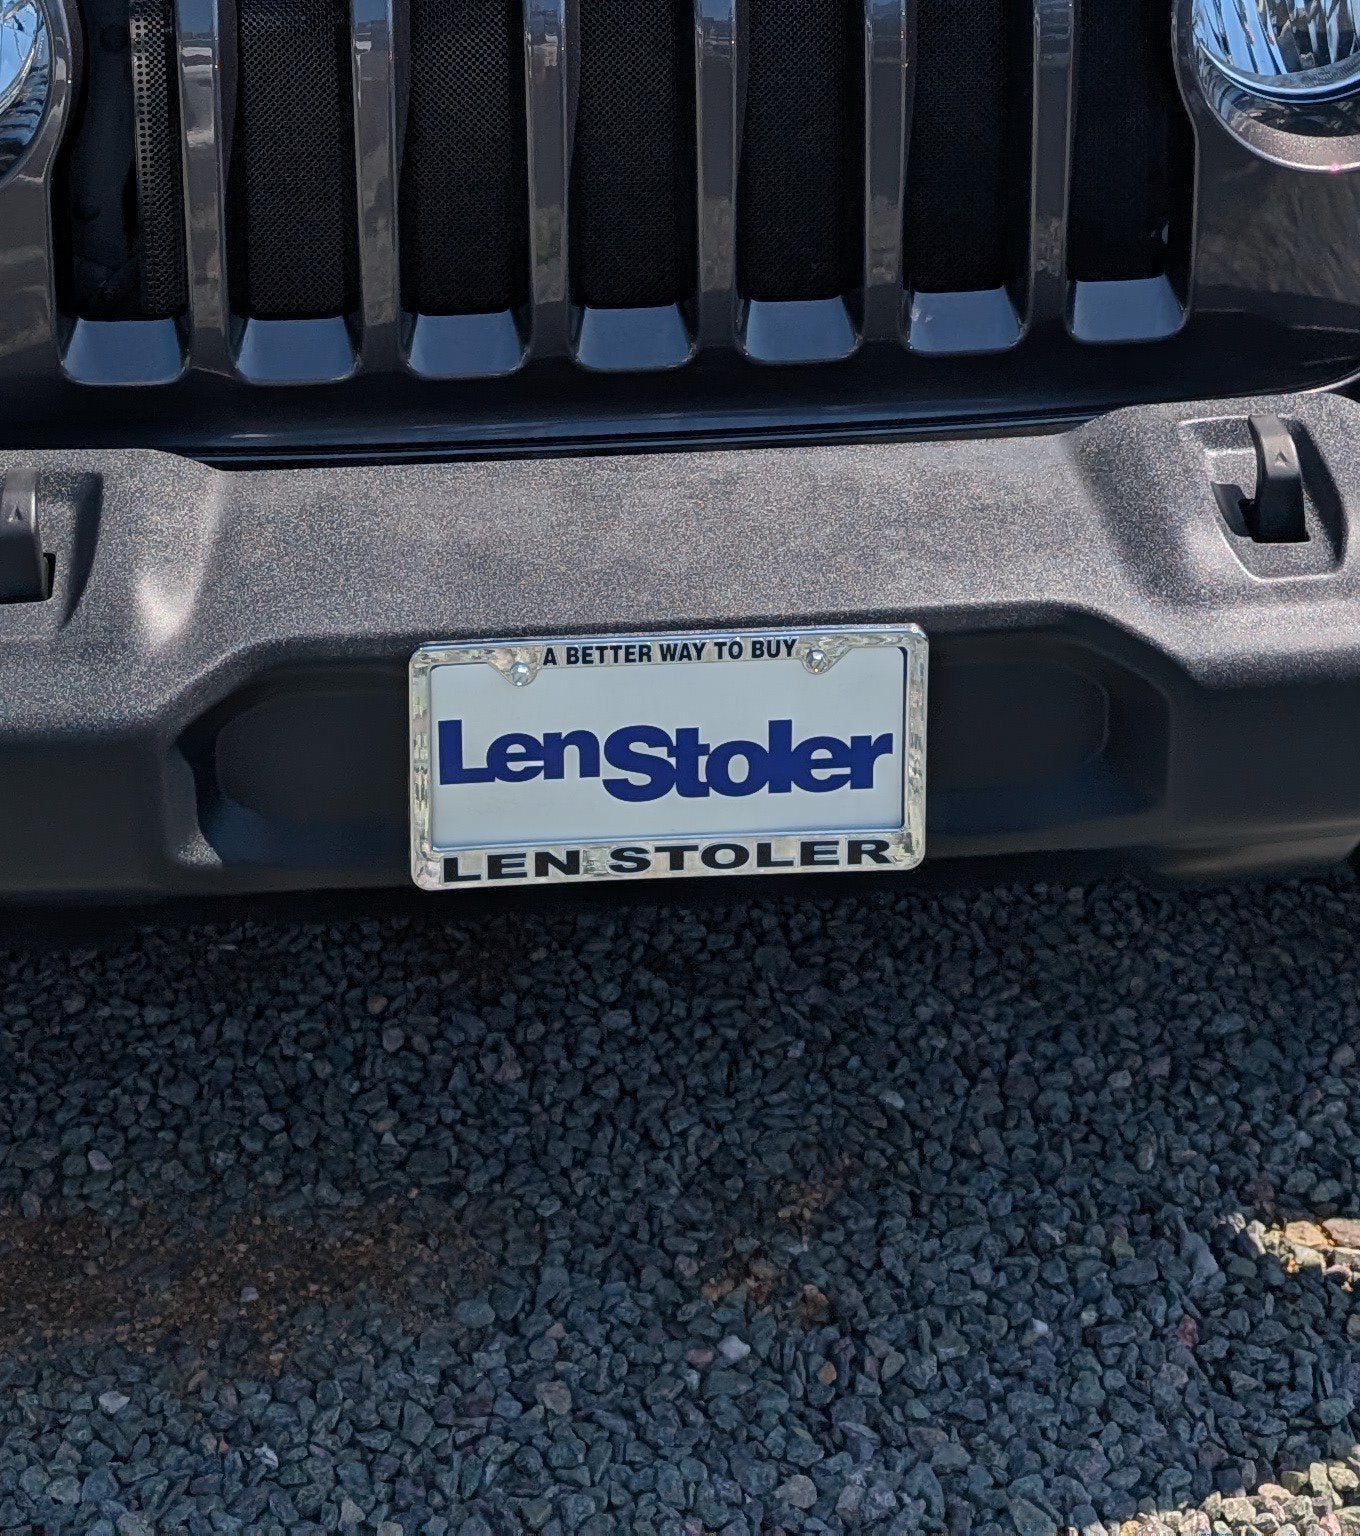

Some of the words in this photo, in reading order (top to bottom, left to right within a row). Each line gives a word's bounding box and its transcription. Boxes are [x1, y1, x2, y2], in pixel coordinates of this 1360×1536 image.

[543, 648, 558, 666] A
[566, 644, 652, 665] BETTER
[659, 642, 707, 662] WAY
[714, 640, 743, 660] TO
[751, 638, 797, 659] BUY
[443, 850, 581, 884] LEN
[608, 839, 891, 874] STOLER
